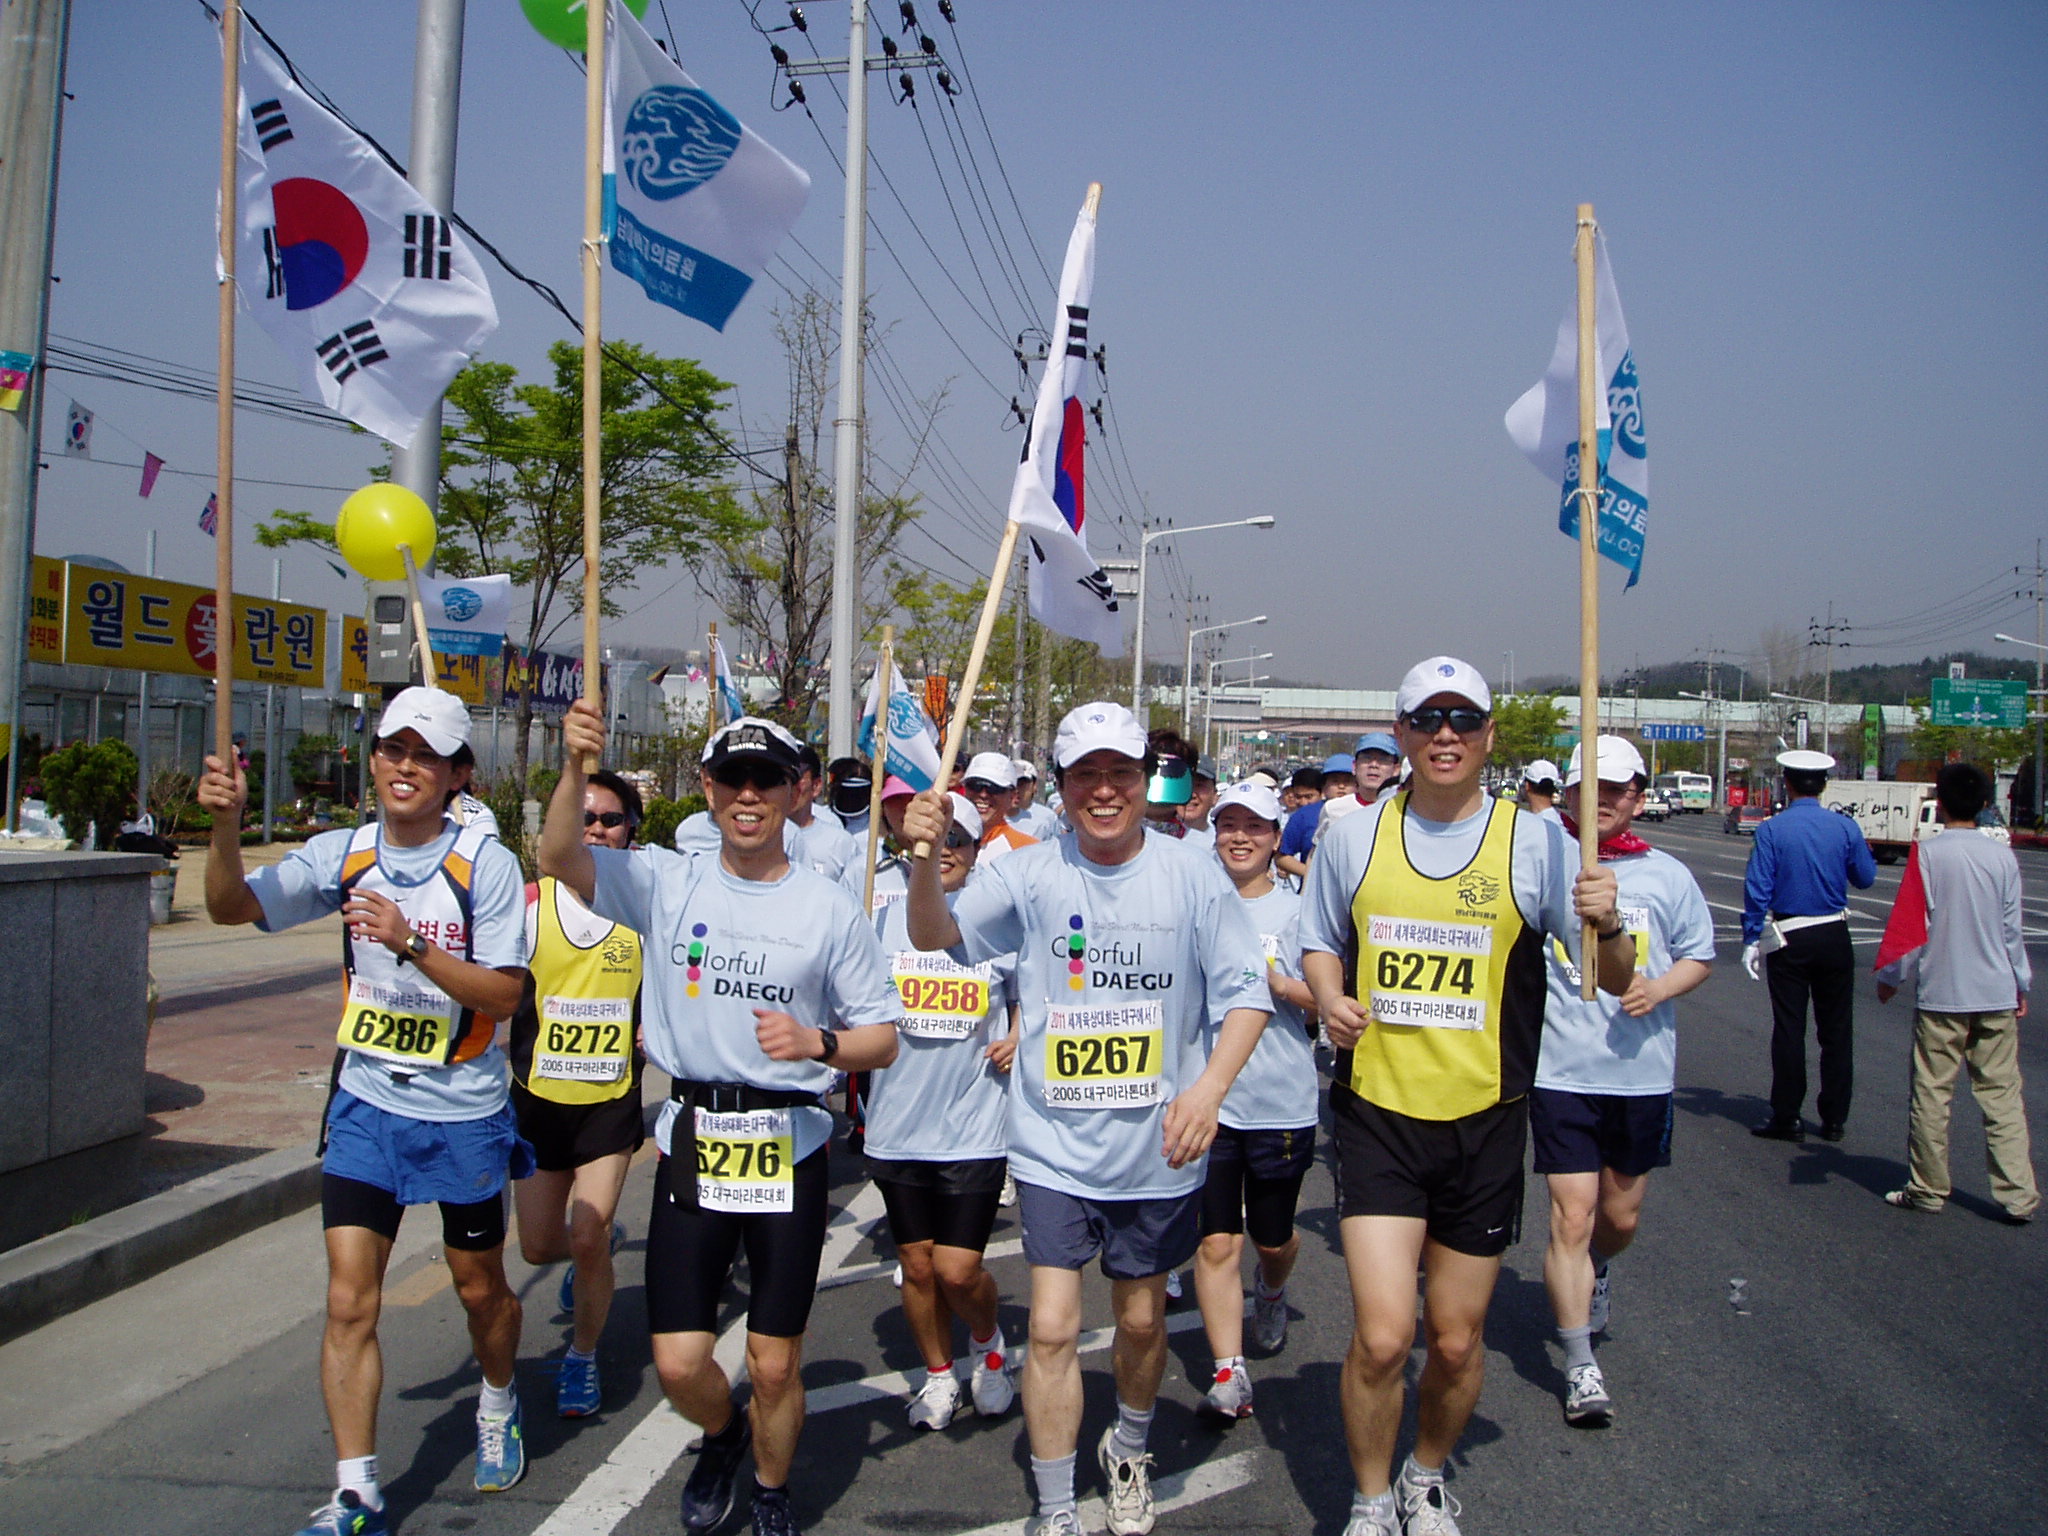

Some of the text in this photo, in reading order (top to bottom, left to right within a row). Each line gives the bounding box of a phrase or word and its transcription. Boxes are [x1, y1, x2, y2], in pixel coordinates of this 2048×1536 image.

[1374, 921, 1392, 940] 2011
[899, 957, 915, 971] 2011
[1377, 950, 1475, 995] 6274
[713, 978, 794, 1004] DAEGU
[1092, 970, 1173, 991] DAEGU
[902, 977, 980, 1013] 9258
[1051, 1011, 1066, 1029] 2011
[1373, 996, 1478, 1021] 2005 대구마라톤대회
[351, 1008, 438, 1055] 6286
[547, 1022, 622, 1053] 6272
[541, 1058, 625, 1075] 2005 대구마라톤대회
[1055, 1035, 1151, 1077] 6267
[1052, 1080, 1158, 1102] 2005 대구마라톤대회
[696, 1139, 781, 1178] 6276
[713, 1187, 786, 1204] 대구마라톤대회
